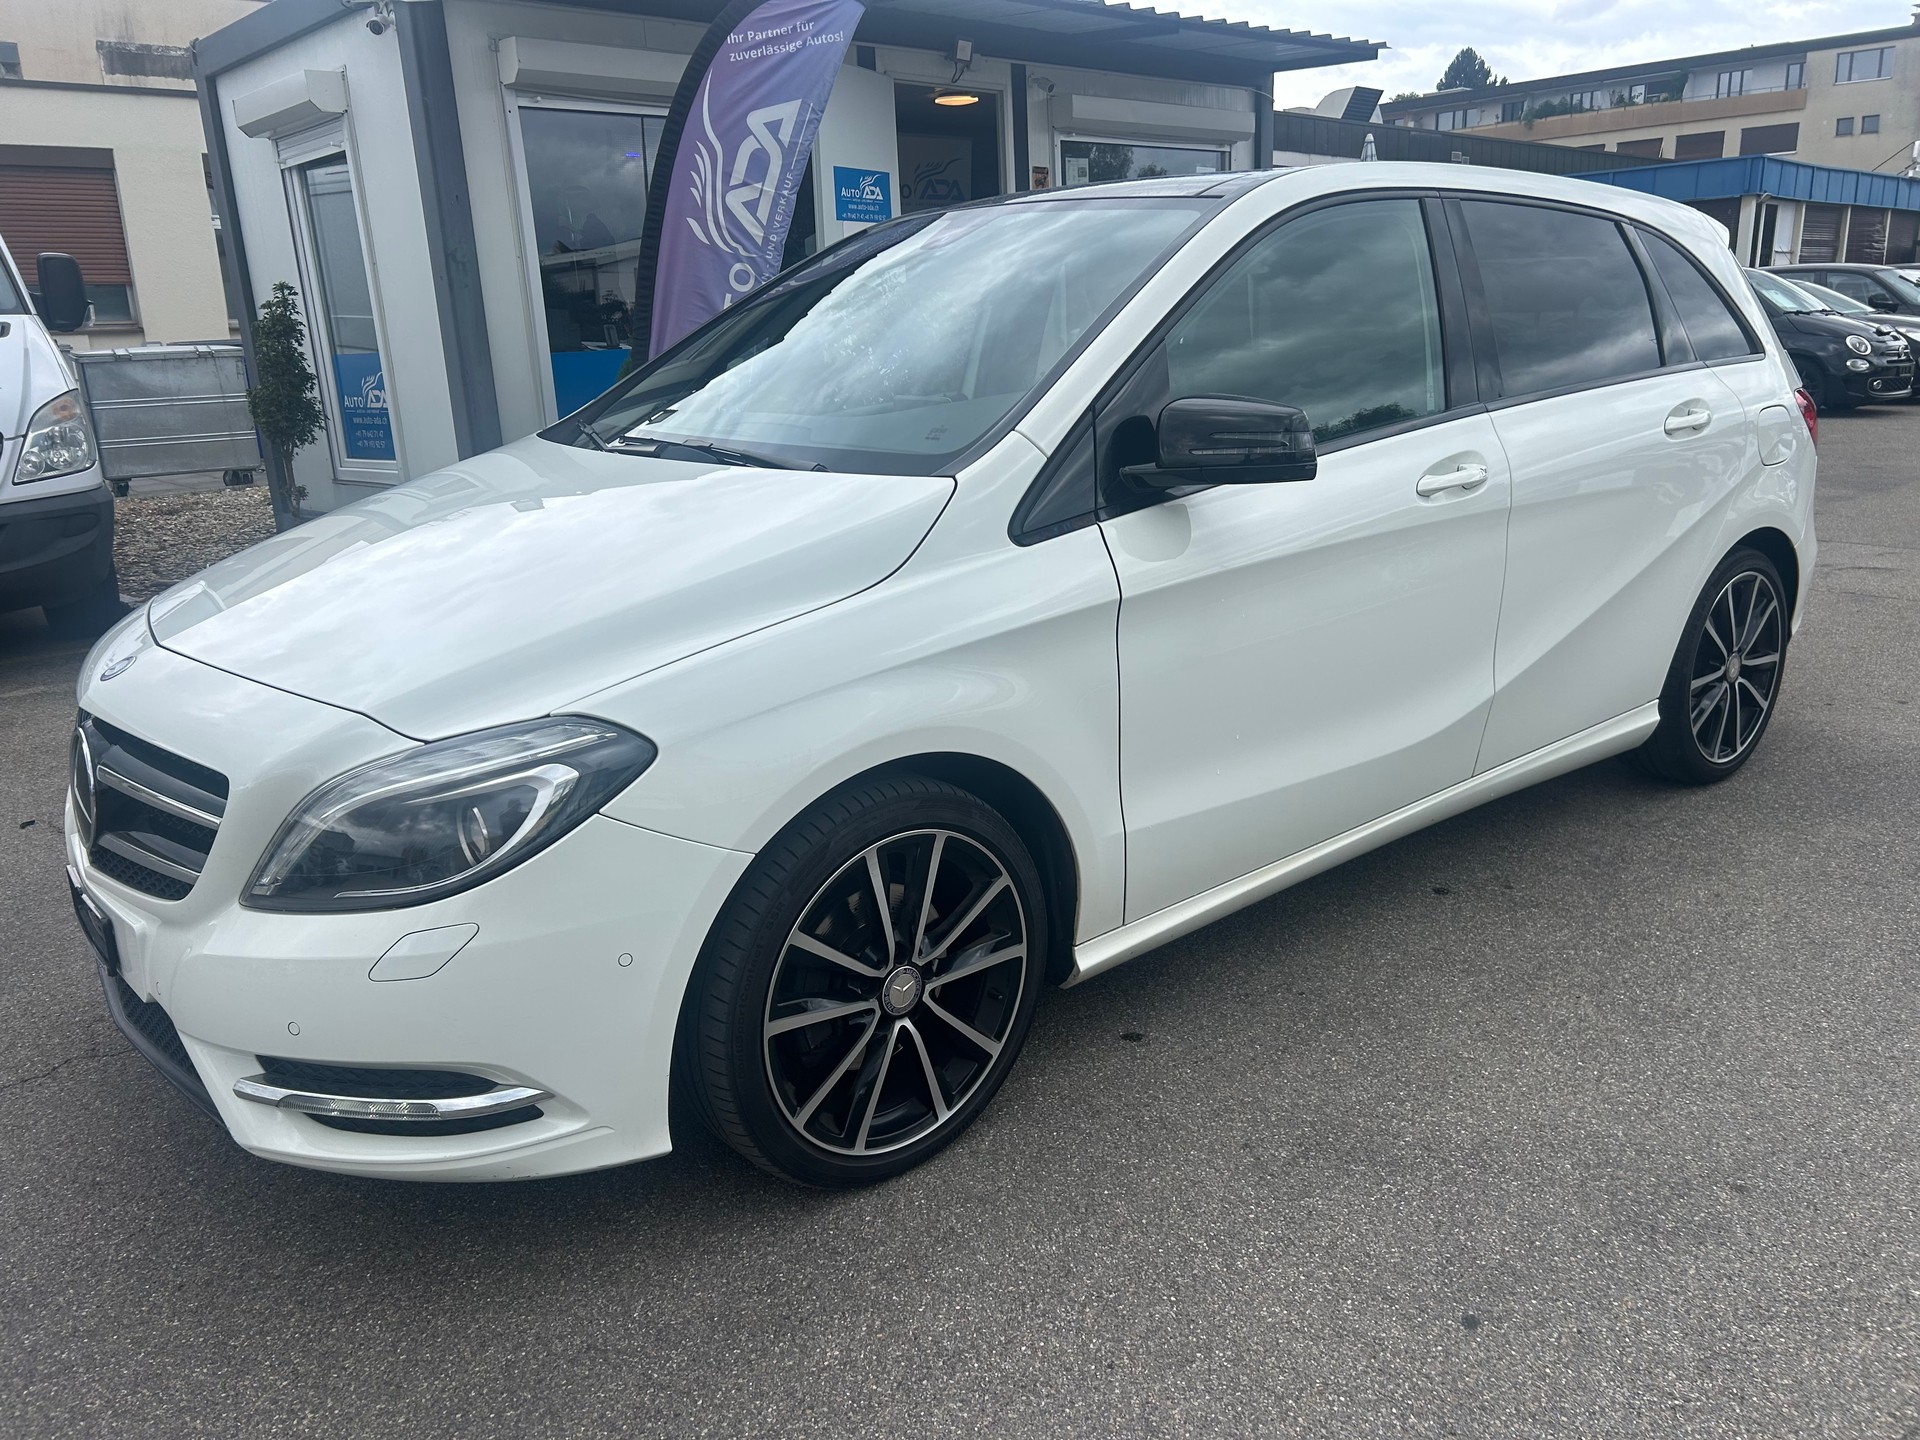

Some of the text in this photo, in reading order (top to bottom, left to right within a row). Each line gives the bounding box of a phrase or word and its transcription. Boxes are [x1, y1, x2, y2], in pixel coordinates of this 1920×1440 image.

[727, 20, 815, 44] Ihr Partner für
[729, 30, 844, 62] zuverlässige Autos!
[724, 98, 802, 247] ADA
[862, 186, 884, 200] ADA
[919, 178, 965, 201] ADA
[765, 234, 777, 259] UND
[773, 172, 794, 230] VERKAUF
[352, 416, 387, 425] www.auto-ada.ch
